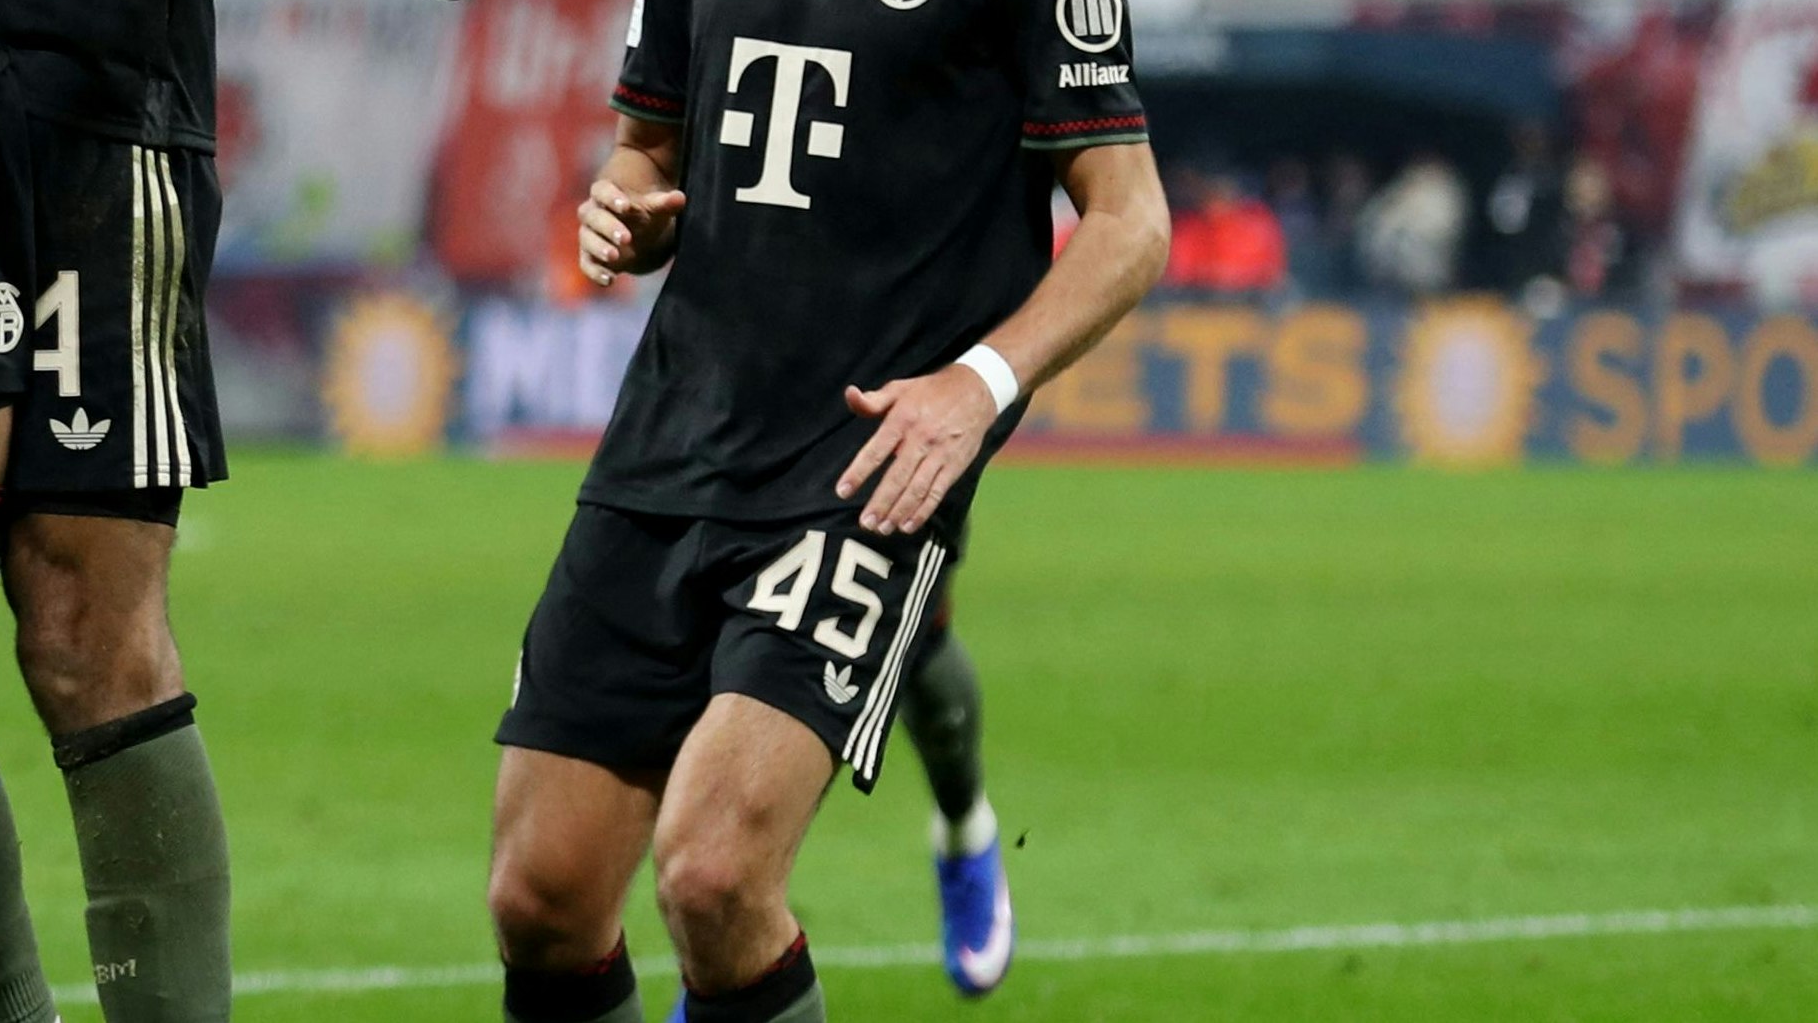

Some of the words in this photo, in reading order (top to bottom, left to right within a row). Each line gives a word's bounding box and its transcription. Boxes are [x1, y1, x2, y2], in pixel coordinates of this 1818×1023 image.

[719, 36, 853, 210] T
[1059, 62, 1130, 88] Allianz
[1048, 306, 1370, 434] ETS
[1570, 310, 1818, 466] SPO
[746, 529, 894, 659] 45
